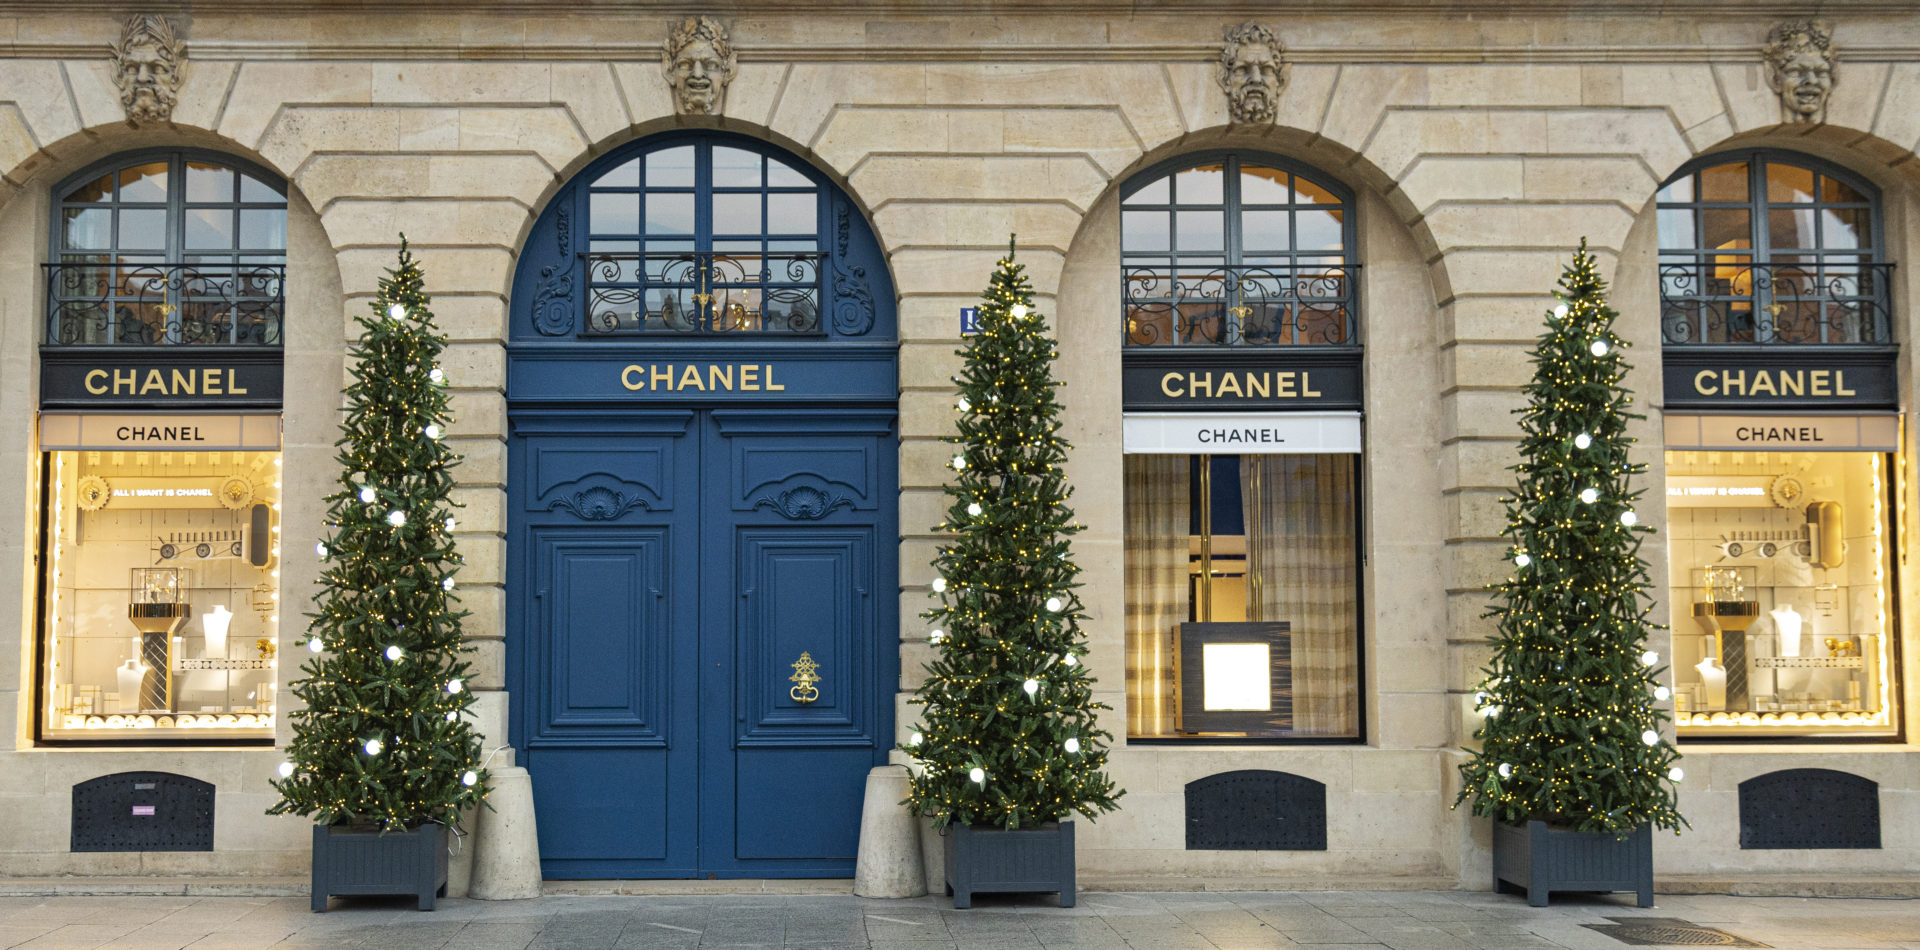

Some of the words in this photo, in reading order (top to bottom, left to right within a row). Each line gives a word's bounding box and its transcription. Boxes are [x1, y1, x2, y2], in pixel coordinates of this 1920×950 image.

[84, 368, 248, 395] CHANEL
[621, 364, 785, 391] CHANEL
[1161, 371, 1322, 398] CHANEL
[1694, 369, 1856, 396] CHANEL
[116, 426, 205, 441] CHANEL
[1198, 429, 1285, 443] CHANEL
[1736, 427, 1824, 441] CHANEL
[113, 489, 130, 497] ALL
[131, 489, 135, 497] I
[136, 489, 164, 497] WANT
[165, 489, 175, 497] IS
[176, 489, 213, 497] CHANEL
